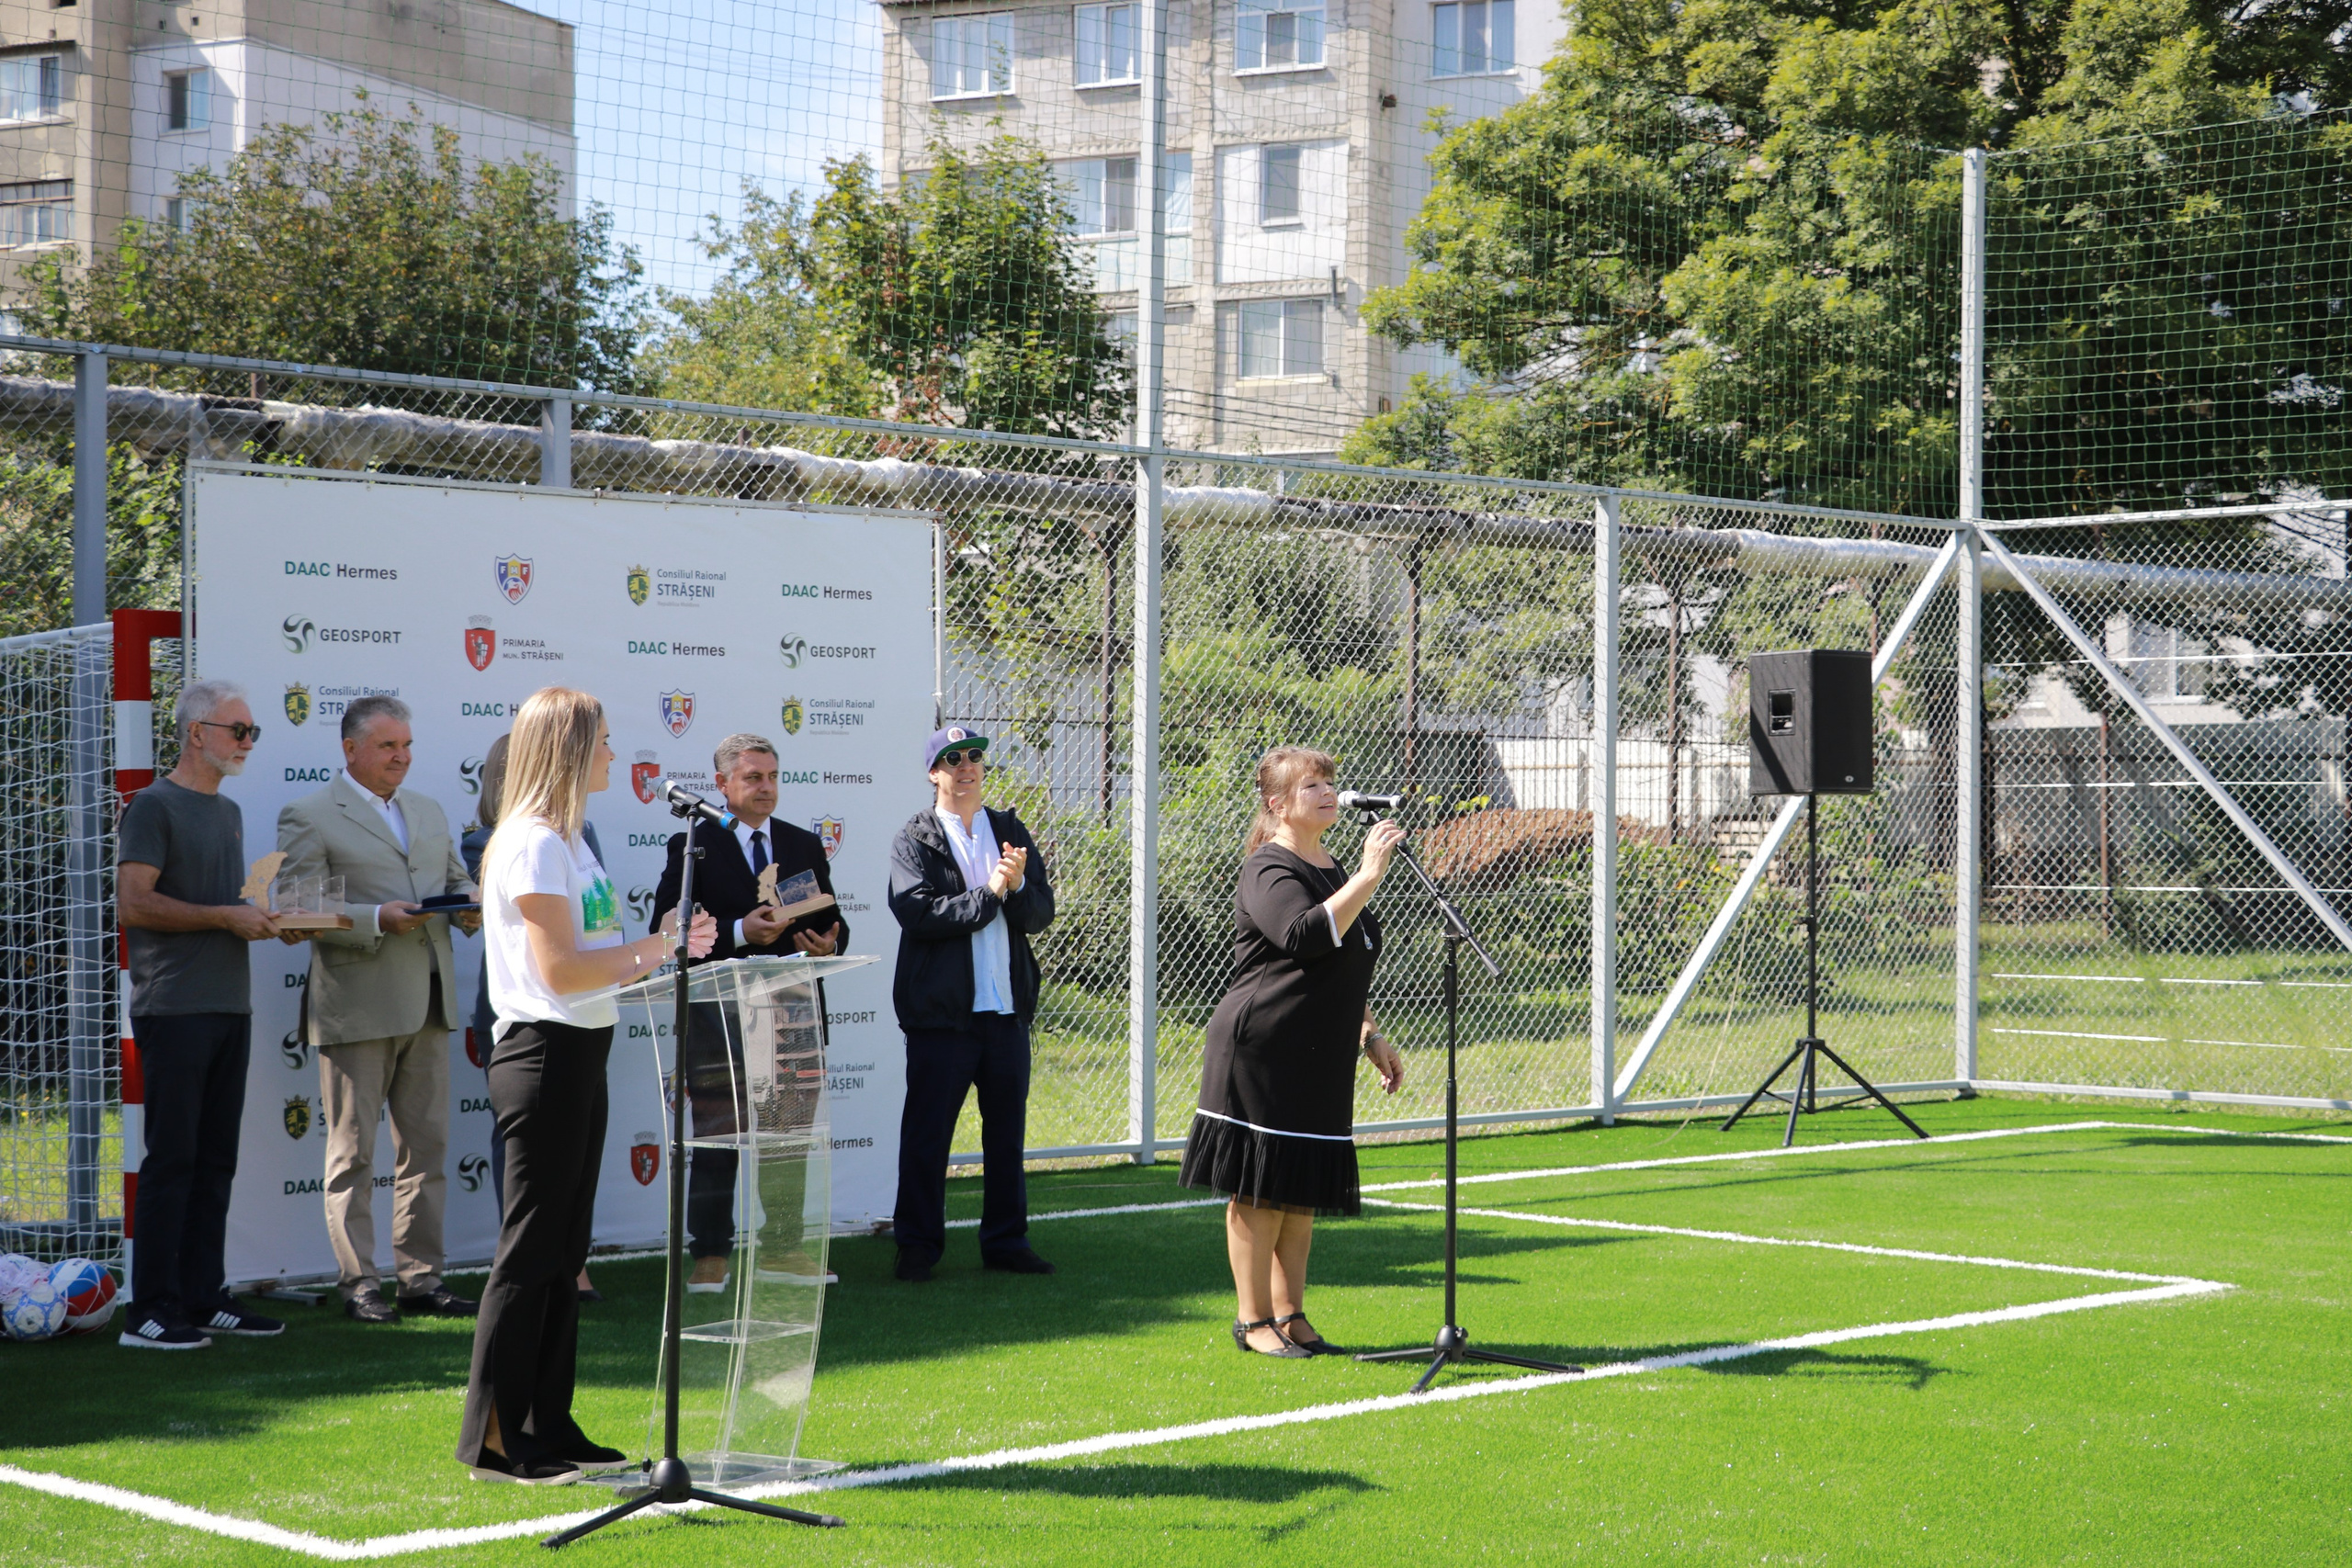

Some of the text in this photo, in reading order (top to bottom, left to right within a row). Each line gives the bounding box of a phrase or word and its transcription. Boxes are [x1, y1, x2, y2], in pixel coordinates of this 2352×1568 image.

[285, 560, 398, 580] DAAC Hermes
[657, 569, 727, 581] Consiliul Raional
[657, 581, 715, 601] STRĂȘENI
[782, 583, 873, 600] DAAC Hermes
[320, 628, 401, 643] GEOSPORT
[503, 638, 546, 649] PRIMARIA
[628, 640, 726, 657] DAAC Hermes
[810, 645, 876, 659] GEOSPORT
[319, 686, 361, 696] Consiliul
[462, 703, 504, 716] DAAC
[809, 698, 875, 708] Consiliul Raional
[809, 711, 864, 728] STRĂȘENI
[285, 768, 331, 782] DAAC
[667, 772, 707, 780] PRIMARIA
[782, 771, 873, 784] DAAC Hermes
[628, 833, 668, 846] DAAC
[840, 903, 871, 913] TRĂȘENI
[845, 1062, 875, 1073] Raional
[460, 1098, 493, 1112] DAA
